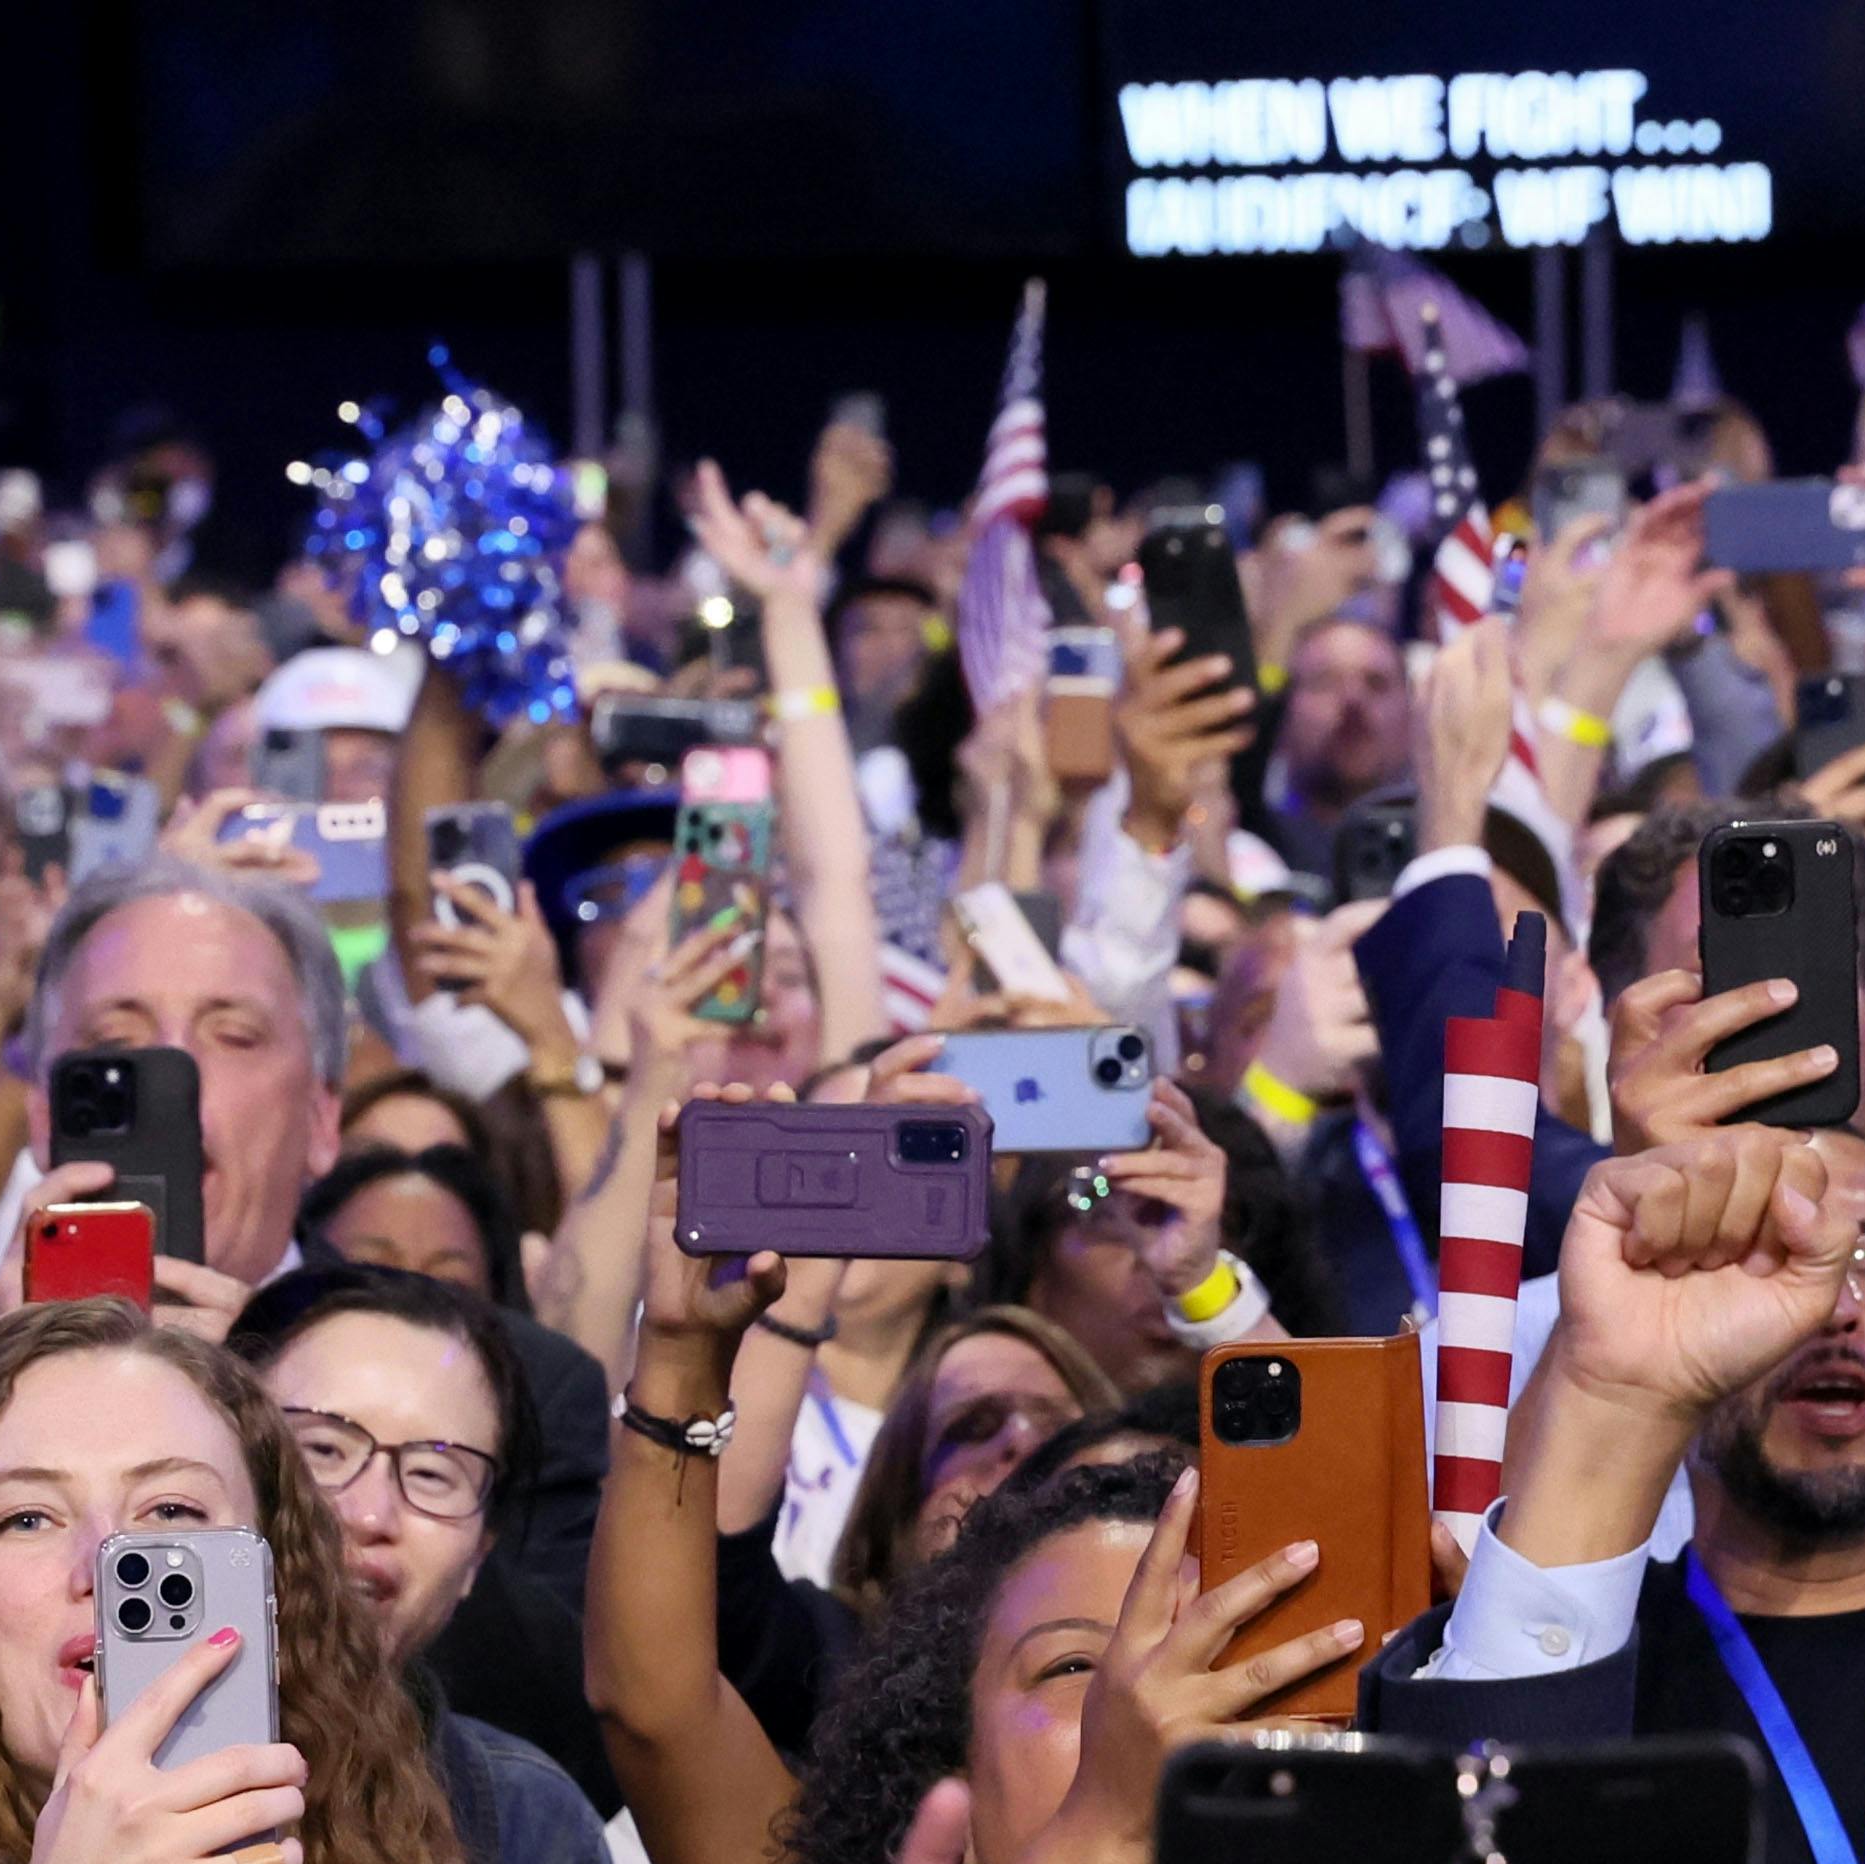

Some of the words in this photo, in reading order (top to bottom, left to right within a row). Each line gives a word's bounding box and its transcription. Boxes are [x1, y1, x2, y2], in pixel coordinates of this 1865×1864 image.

[1118, 79, 1327, 167] WHEN
[1328, 74, 1447, 162] WE
[1493, 165, 1609, 248] WE
